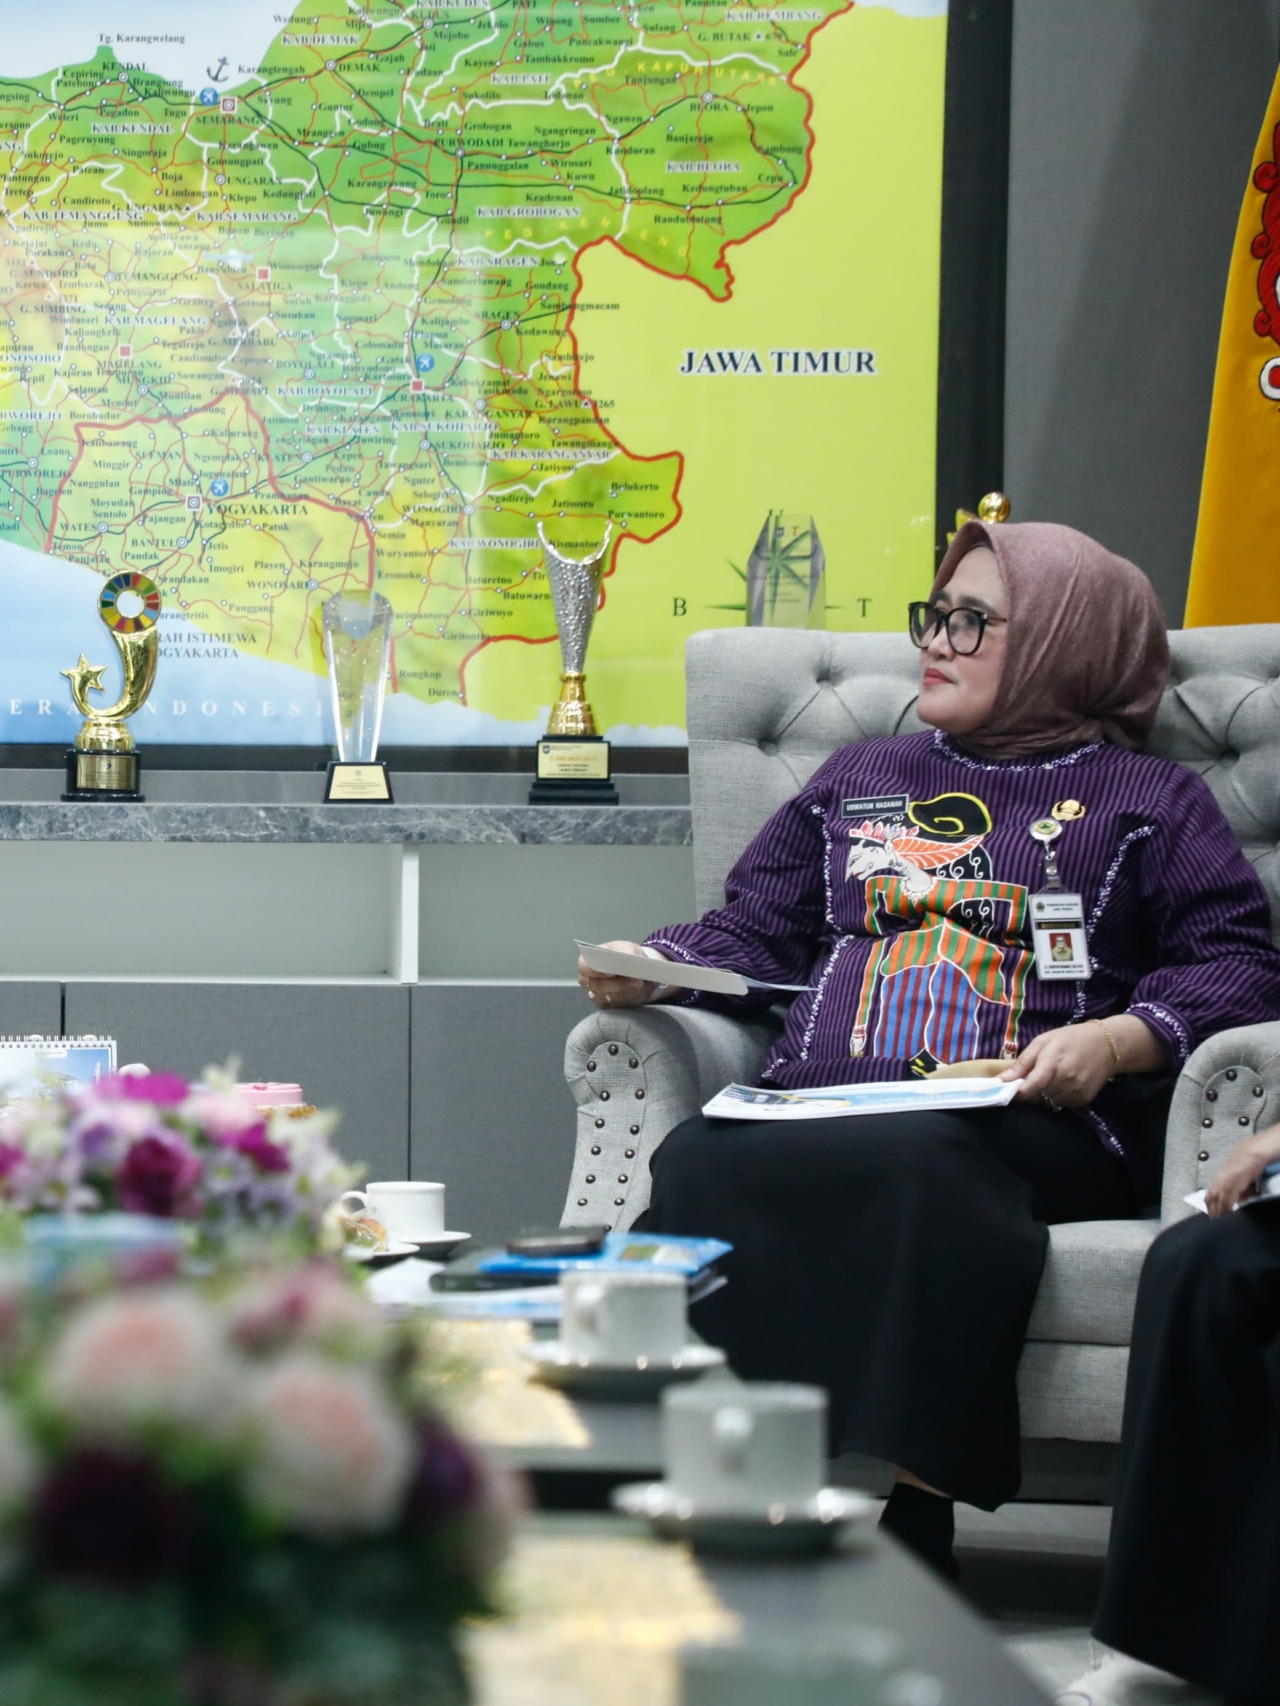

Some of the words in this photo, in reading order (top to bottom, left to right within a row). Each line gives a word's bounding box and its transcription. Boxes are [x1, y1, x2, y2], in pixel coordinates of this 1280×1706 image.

[274, 15, 312, 24] Wedung
[583, 16, 620, 25] Sumber
[643, 23, 675, 33] Sulang
[99, 34, 112, 43] Tg.
[117, 34, 185, 44] Karangwelang
[514, 40, 544, 48] Gabus
[778, 49, 798, 57] Sale
[103, 63, 148, 71] KENDAL
[339, 64, 380, 72] DEMAK
[464, 59, 495, 68] Kayen
[238, 65, 305, 75] Karangtengah
[63, 70, 104, 80] Cepiring
[463, 91, 500, 100] Sukolilo
[100, 109, 139, 118] Pegadon
[746, 104, 774, 114] Jepon
[196, 116, 259, 125] SEMARANG
[606, 115, 643, 124] Ngawen
[464, 123, 511, 132] Grobogan
[60, 136, 115, 145] Pageruyung
[434, 139, 503, 148] PURWODADI
[73, 166, 104, 174] Patean
[162, 173, 182, 181] Boja
[227, 177, 282, 185] UNGARAN
[758, 174, 783, 184] Cepu
[682, 184, 747, 194] Kedungtuban
[23, 212, 143, 220] KAB.TEMANGGUNG
[197, 212, 296, 222] KAB.SEMARANG
[477, 207, 580, 218] KAB.GROBOGAN
[526, 282, 569, 292] Gondang
[34, 305, 86, 314] SUMBING
[104, 316, 206, 326] KAB.MAGELANG
[679, 350, 763, 375] JAWA
[770, 350, 876, 374] TIMUR
[207, 504, 308, 516] YOGYAKARTA
[61, 523, 97, 532] WATES
[132, 539, 177, 548] BANTUL
[209, 564, 244, 574] Imogiri
[247, 580, 311, 589] WONOSARI
[673, 598, 688, 616] B
[857, 598, 872, 617] T
[187, 632, 256, 644] ISTIMEWA
[428, 689, 457, 697] Duren
[847, 803, 874, 811] USWATUN
